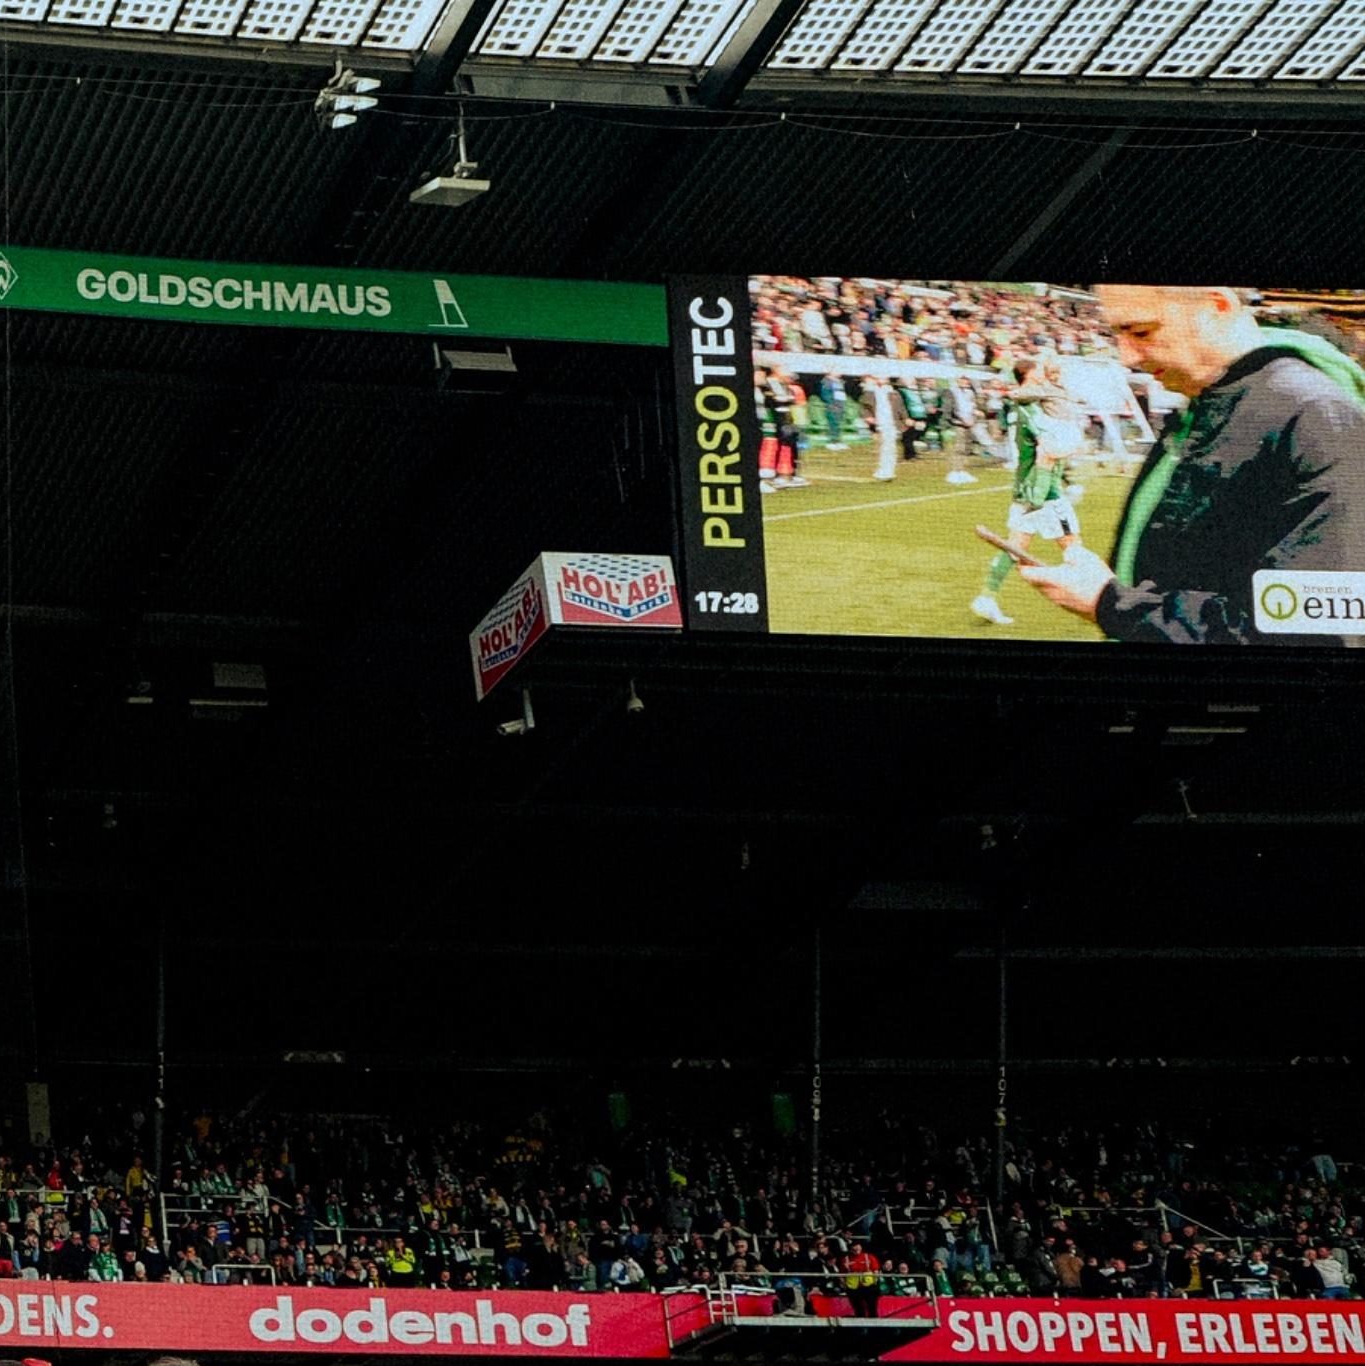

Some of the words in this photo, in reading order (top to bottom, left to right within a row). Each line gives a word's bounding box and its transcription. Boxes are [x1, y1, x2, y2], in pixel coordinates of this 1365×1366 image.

[76, 268, 391, 317] GOLDSCHMAUS
[689, 296, 746, 548] PERSOTEC
[694, 591, 760, 614] 17:28
[250, 1296, 591, 1348] dodenhof
[952, 1311, 1166, 1359] SHOPPEN,
